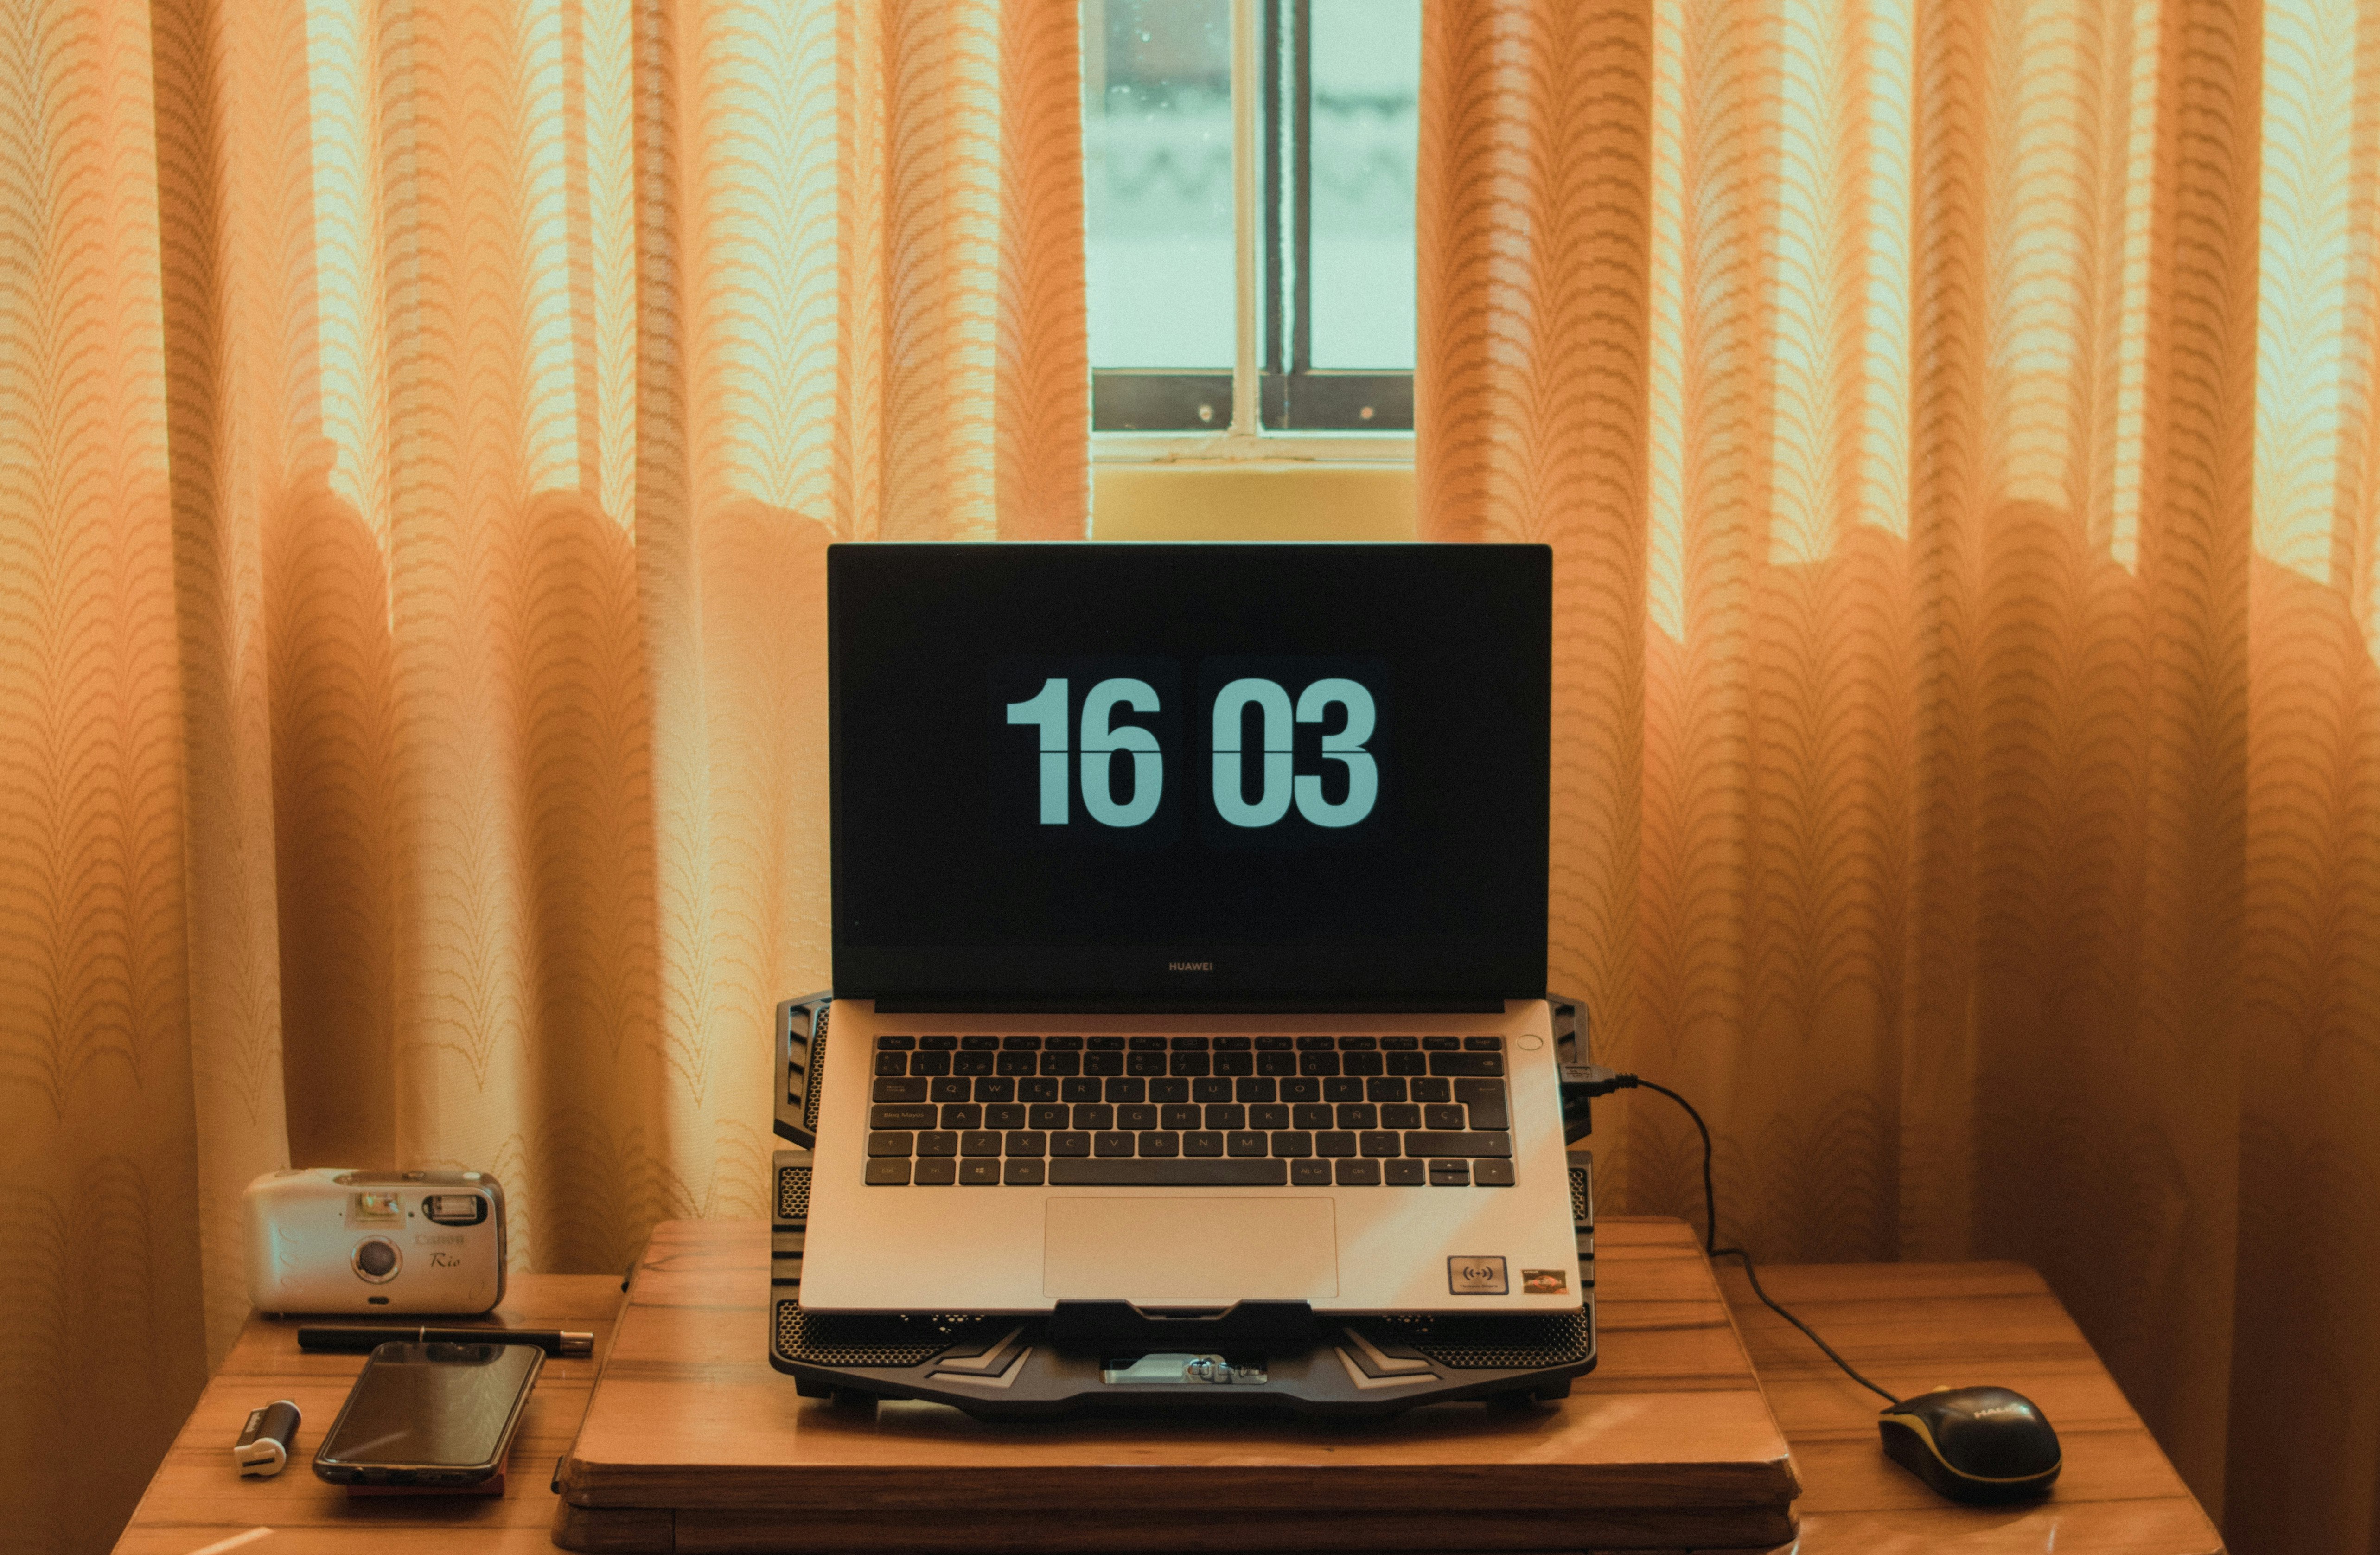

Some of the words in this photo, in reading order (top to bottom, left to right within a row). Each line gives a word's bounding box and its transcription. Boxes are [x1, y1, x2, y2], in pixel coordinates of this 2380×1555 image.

[1006, 678, 1163, 828] 16
[1212, 677, 1378, 828] 03
[1169, 962, 1213, 971] HUAWEI
[430, 1252, 460, 1267] Rio
